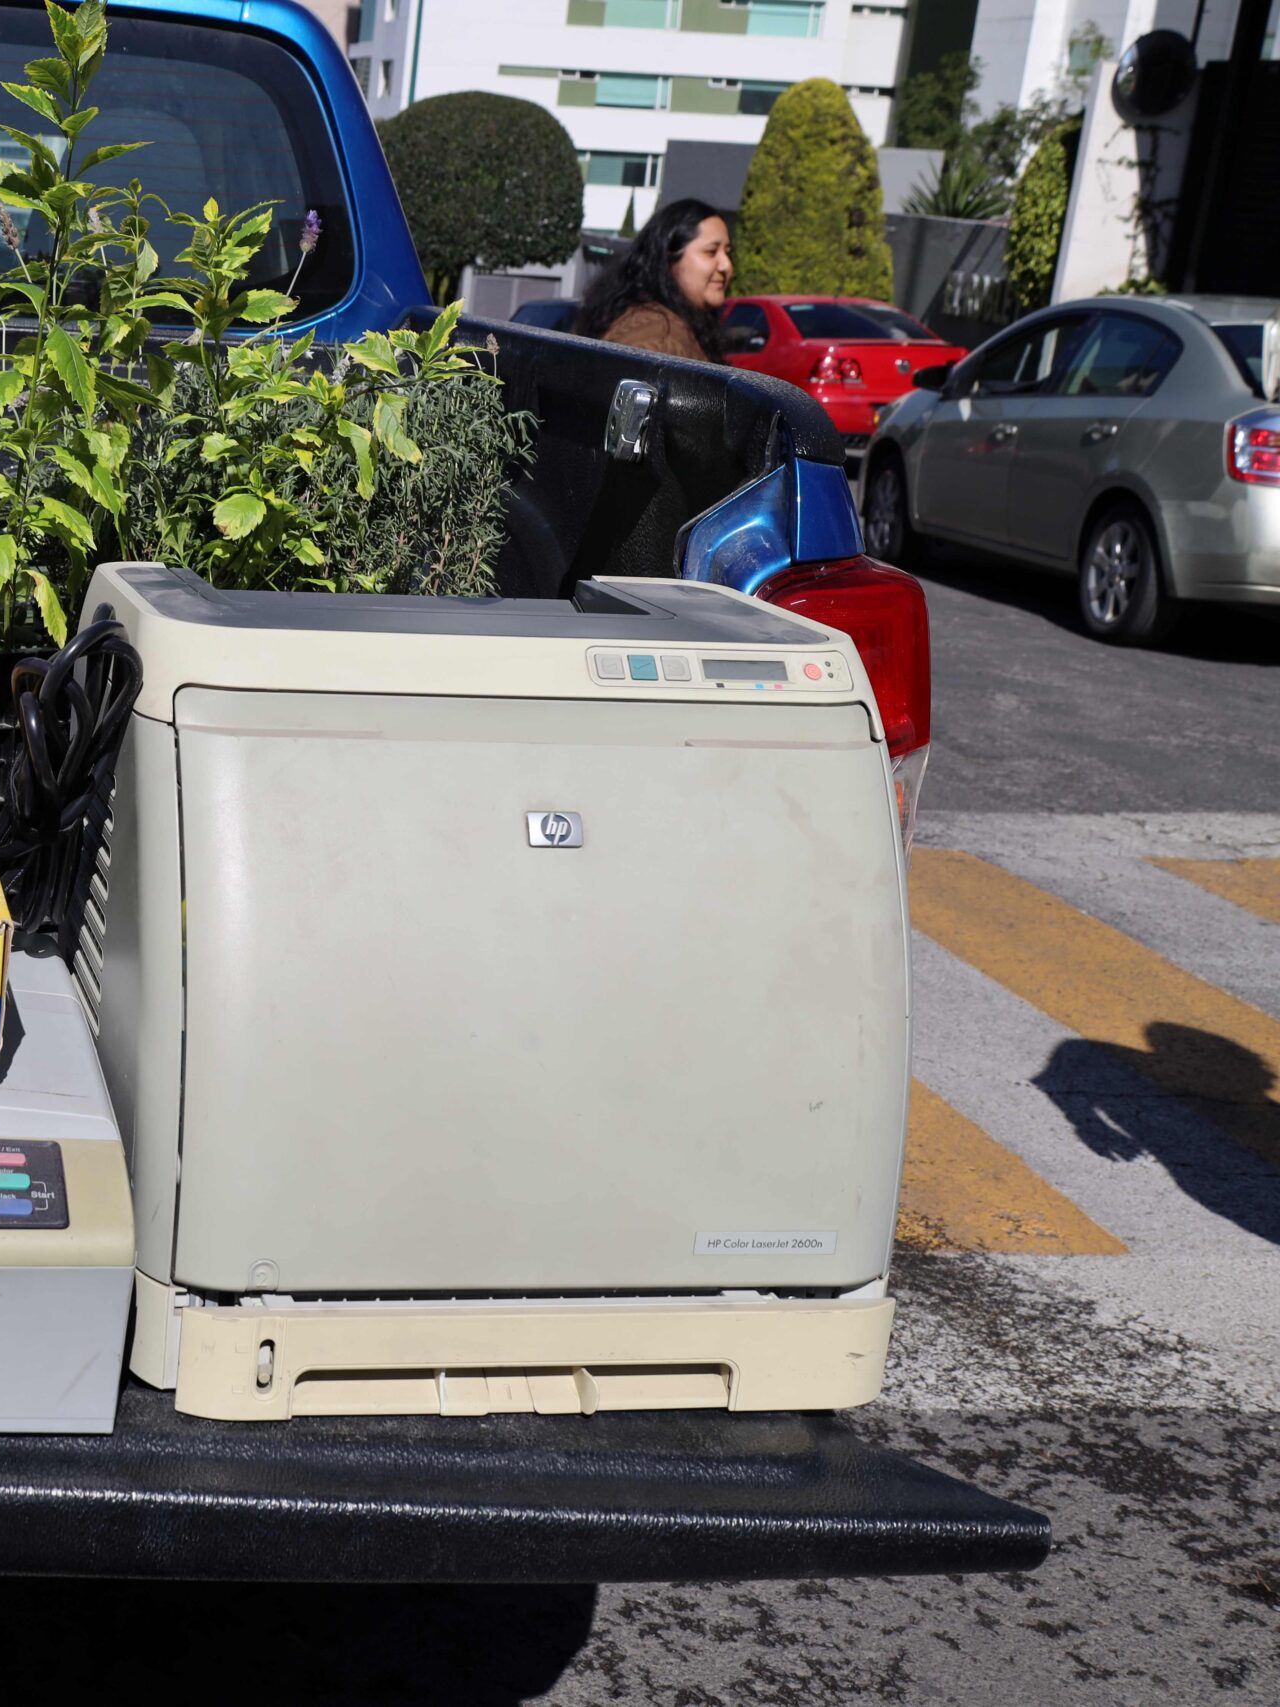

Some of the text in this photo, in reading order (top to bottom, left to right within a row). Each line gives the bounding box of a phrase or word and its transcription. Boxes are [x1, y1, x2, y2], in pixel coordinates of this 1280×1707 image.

[544, 812, 569, 846] hp
[30, 1190, 56, 1199] Start
[707, 1239, 824, 1249] HP Color LaserJet 2600n
